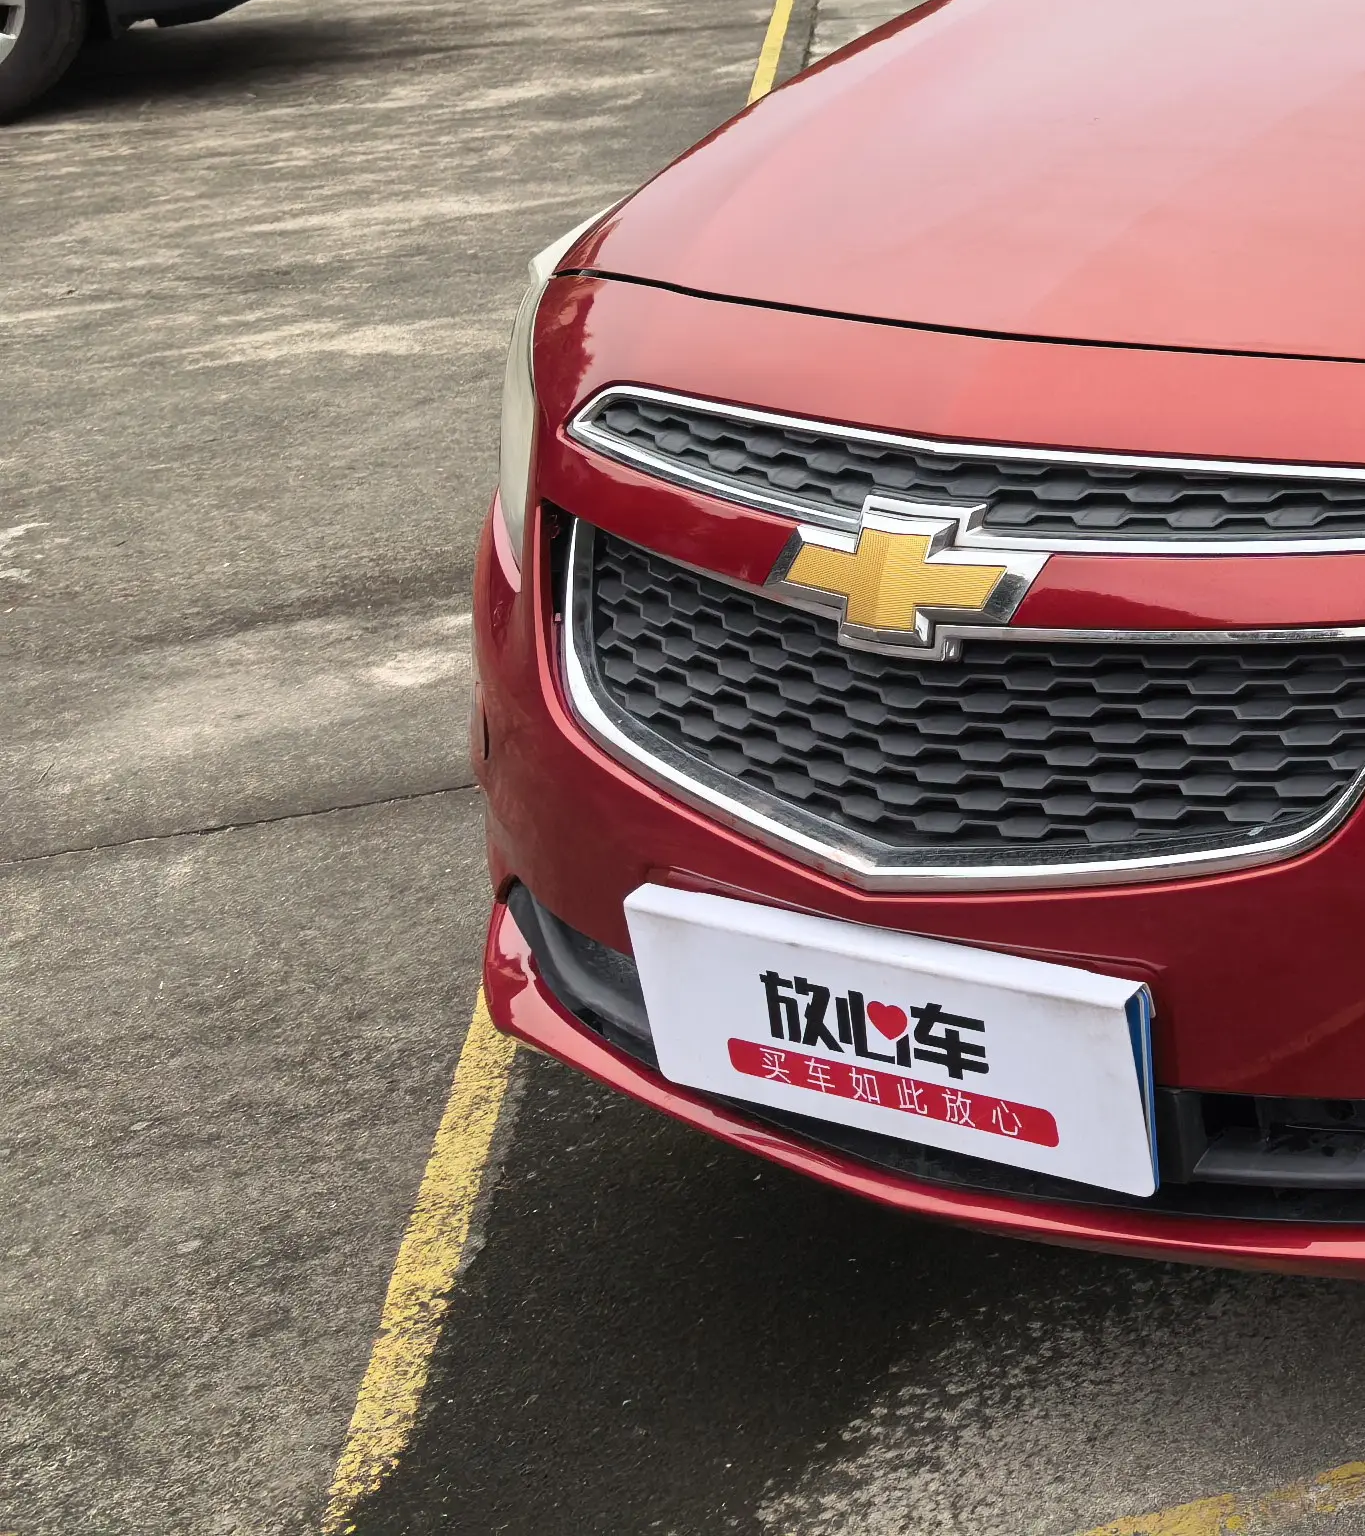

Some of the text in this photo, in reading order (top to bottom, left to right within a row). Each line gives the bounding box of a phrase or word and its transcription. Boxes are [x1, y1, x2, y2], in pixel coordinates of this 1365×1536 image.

[759, 970, 990, 1080] 放心车
[759, 1047, 1022, 1137] 买车如此放心
